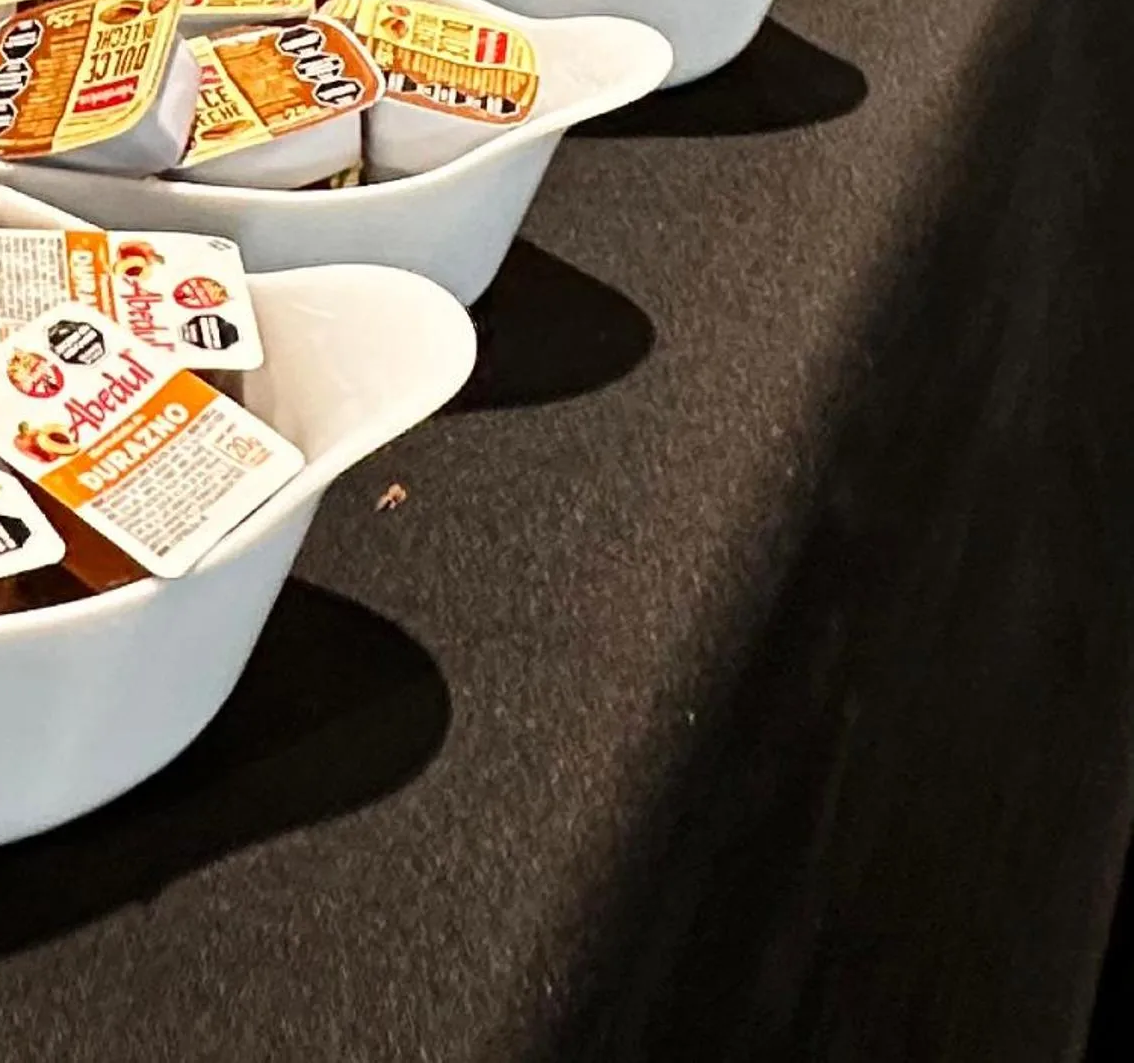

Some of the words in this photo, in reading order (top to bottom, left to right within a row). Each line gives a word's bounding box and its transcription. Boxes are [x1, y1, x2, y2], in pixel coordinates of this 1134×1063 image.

[84, 42, 151, 84] DULCE
[91, 23, 145, 52] LECHE
[65, 348, 154, 442] Abedul
[76, 402, 191, 493] DURAZNO
